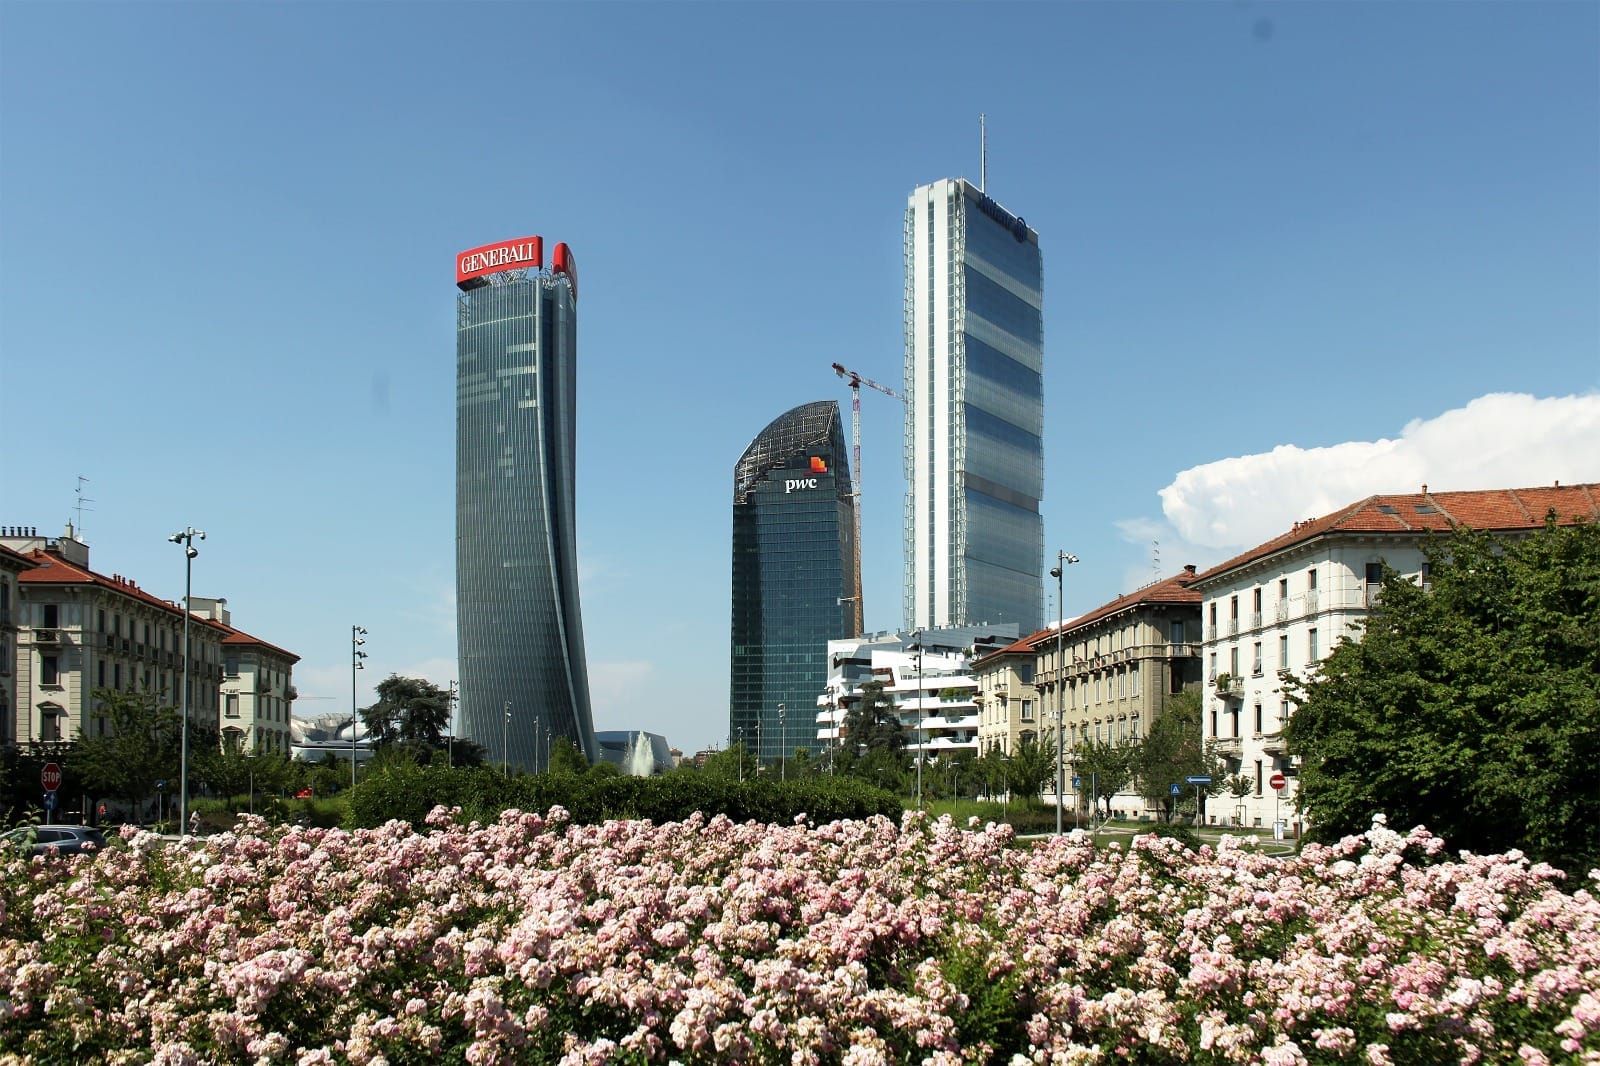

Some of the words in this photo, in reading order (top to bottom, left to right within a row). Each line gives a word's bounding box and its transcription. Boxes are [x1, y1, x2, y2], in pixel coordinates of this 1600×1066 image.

[461, 242, 535, 274] GENERALI
[785, 478, 817, 494] pwc
[43, 771, 60, 783] STOP
